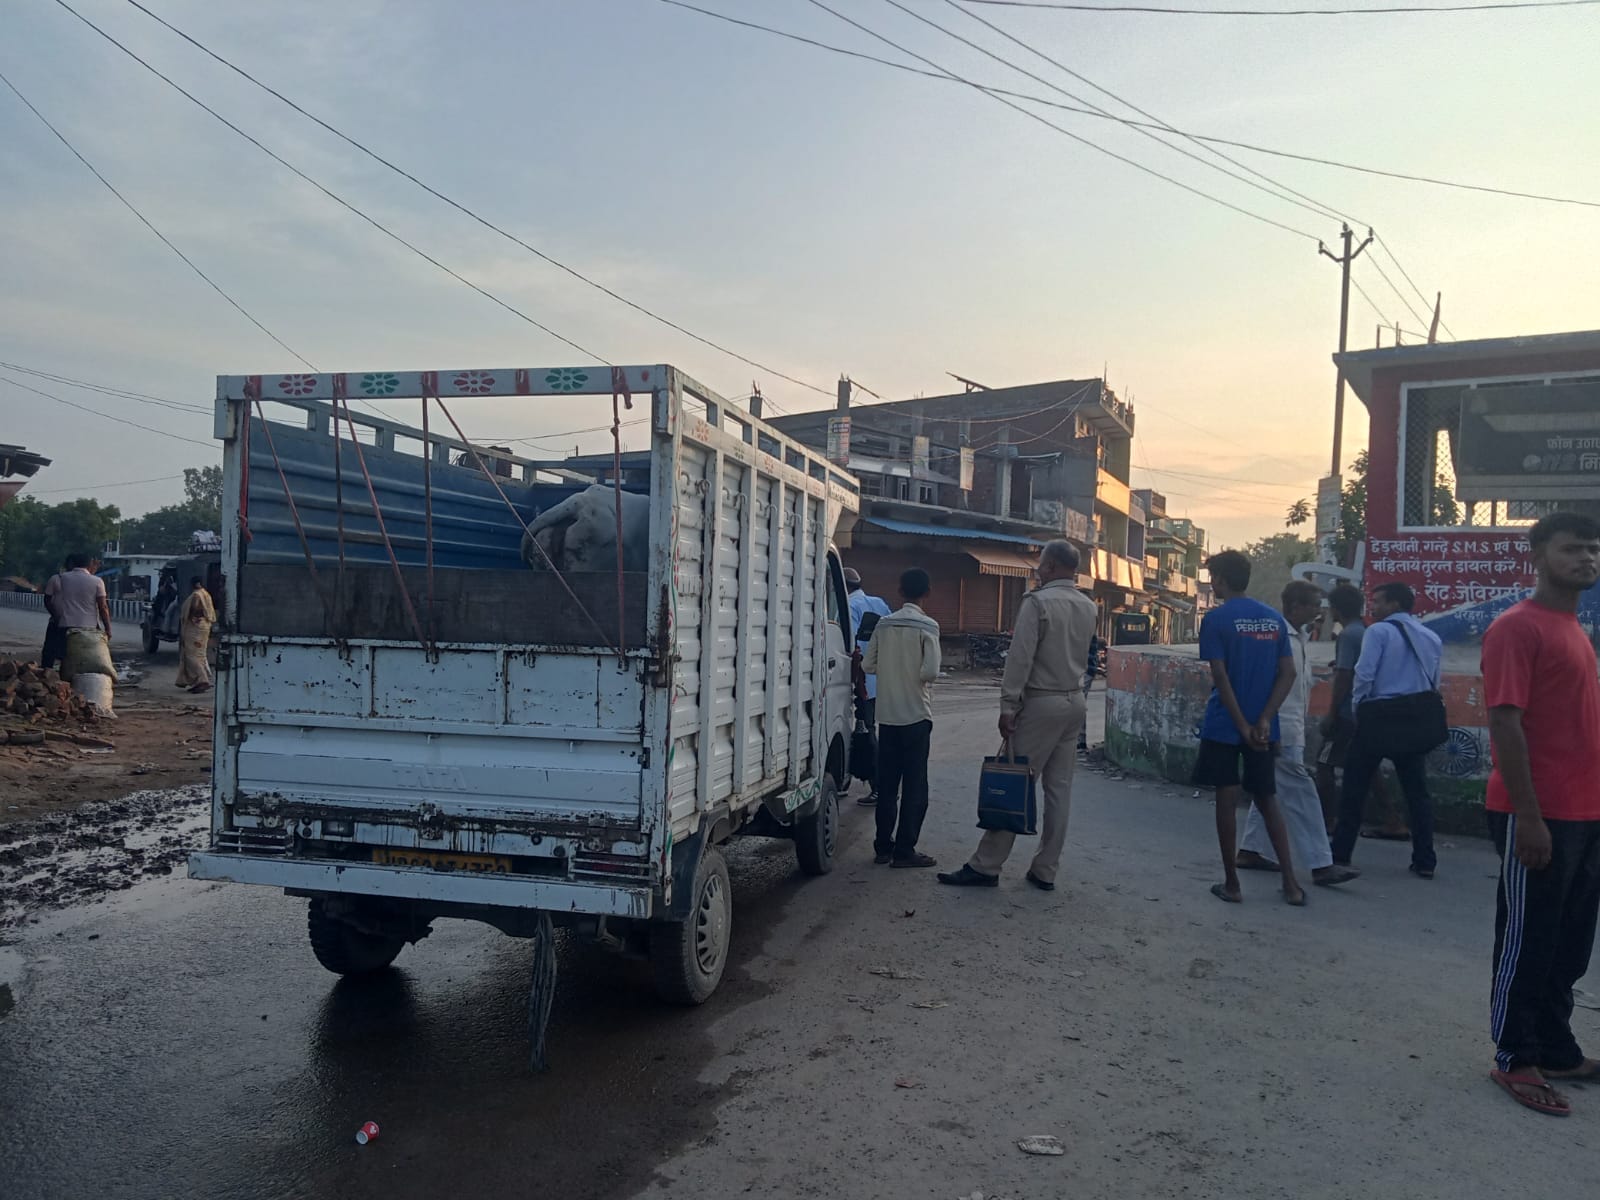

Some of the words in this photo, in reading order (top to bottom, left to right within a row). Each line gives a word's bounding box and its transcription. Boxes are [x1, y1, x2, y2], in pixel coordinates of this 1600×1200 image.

[1513, 536, 1532, 553] फो
[1455, 560, 1492, 574] डायल
[1235, 623, 1280, 632] PERFECT
